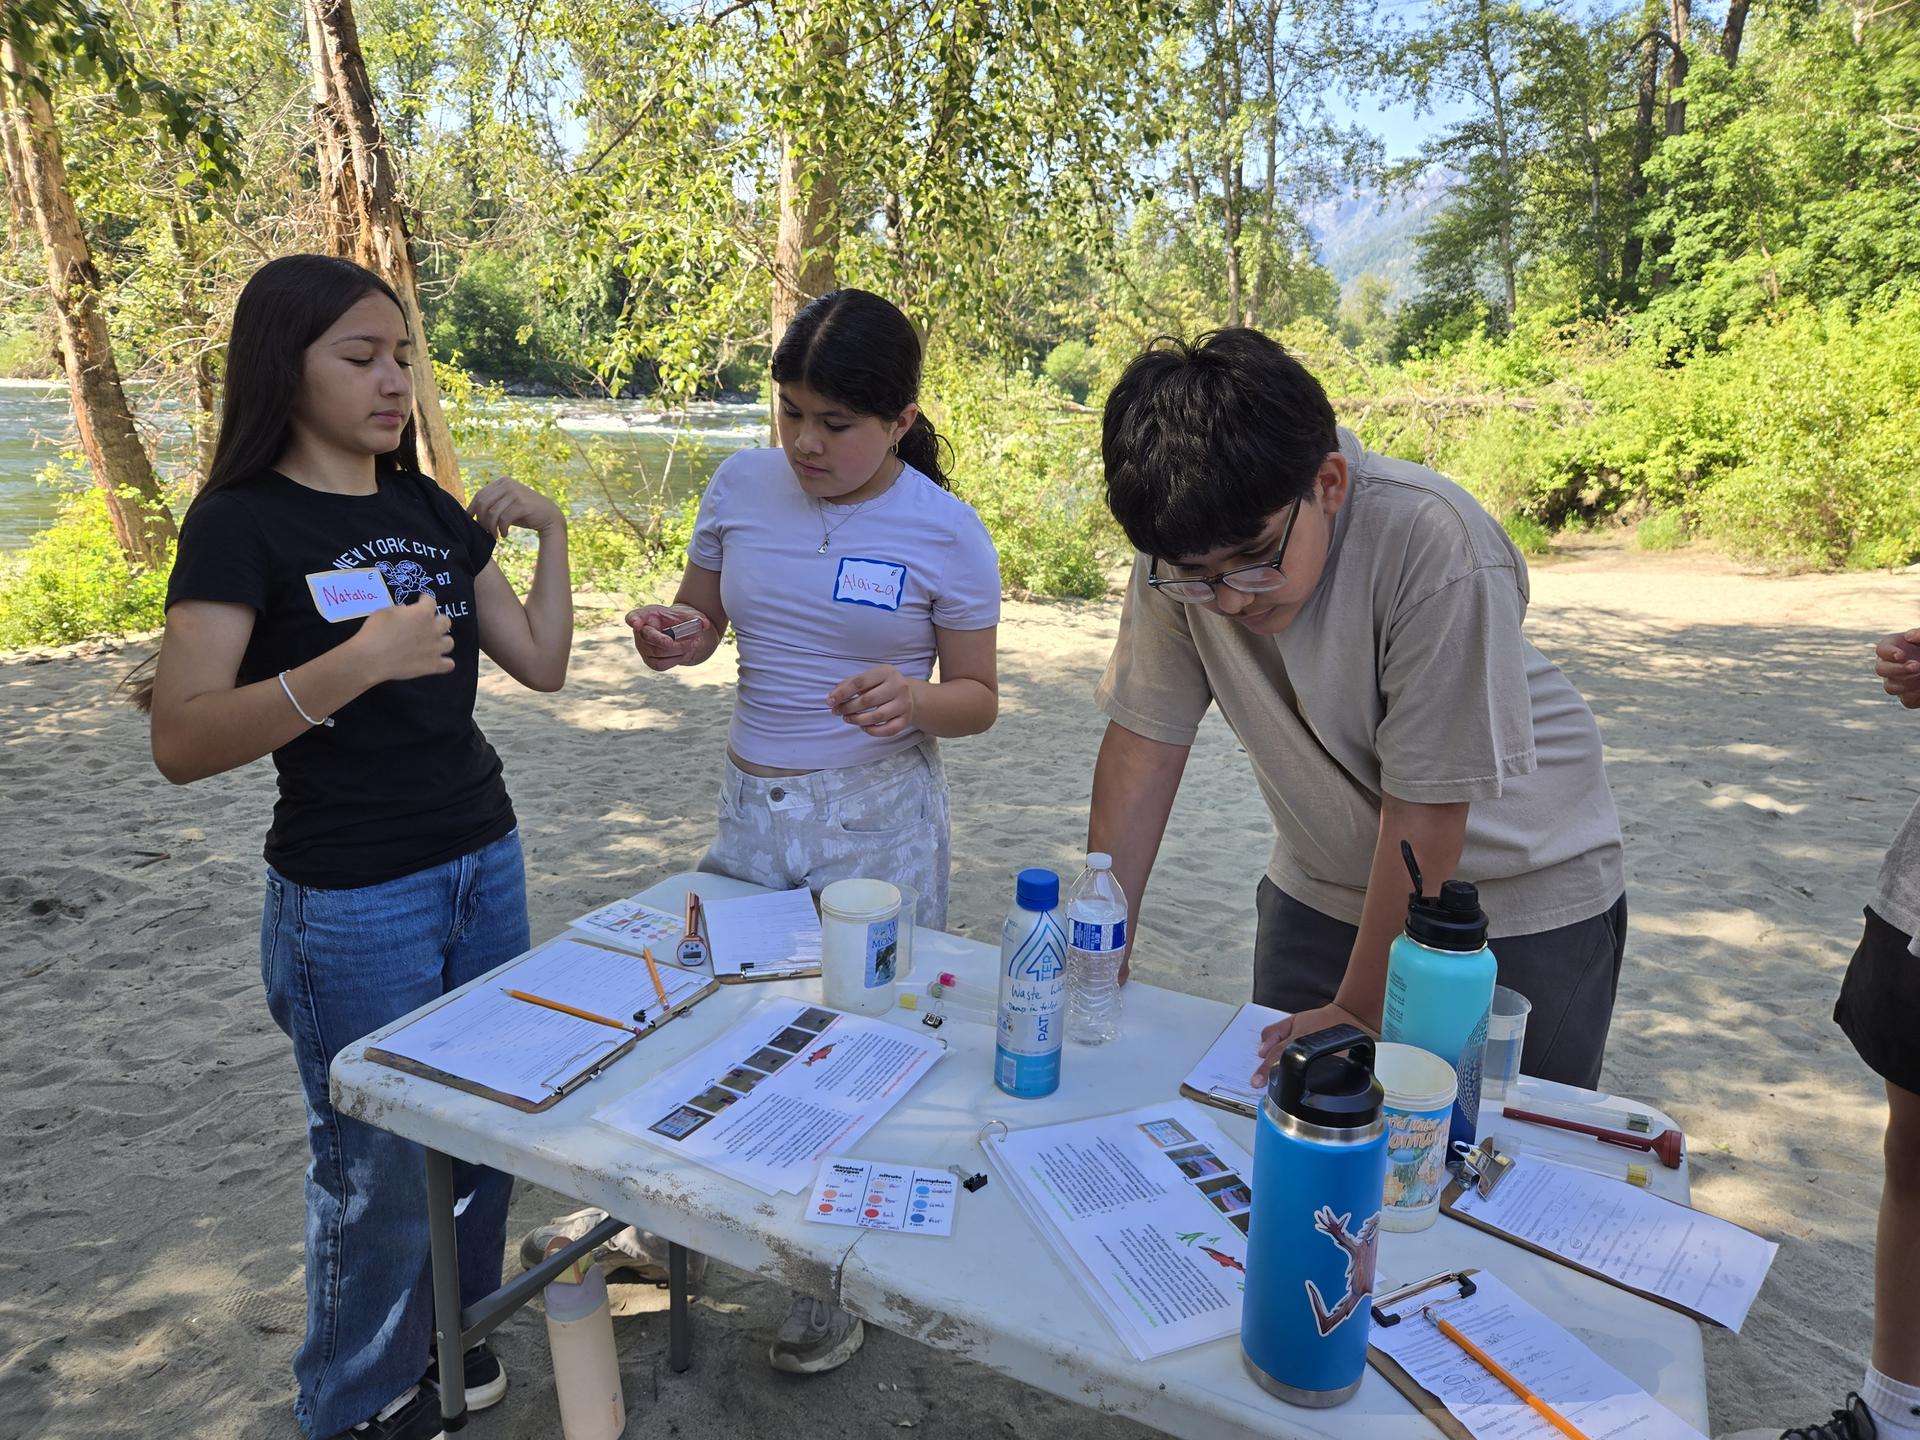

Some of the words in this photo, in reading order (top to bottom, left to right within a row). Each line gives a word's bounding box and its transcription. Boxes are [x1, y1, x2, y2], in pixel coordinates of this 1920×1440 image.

[362, 537, 411, 557] YORK
[412, 541, 450, 560] CITY
[322, 585, 377, 607] Natalia
[1041, 954, 1052, 982] TER
[1010, 983, 1042, 1001] Waste
[832, 1164, 864, 1172] dissolved
